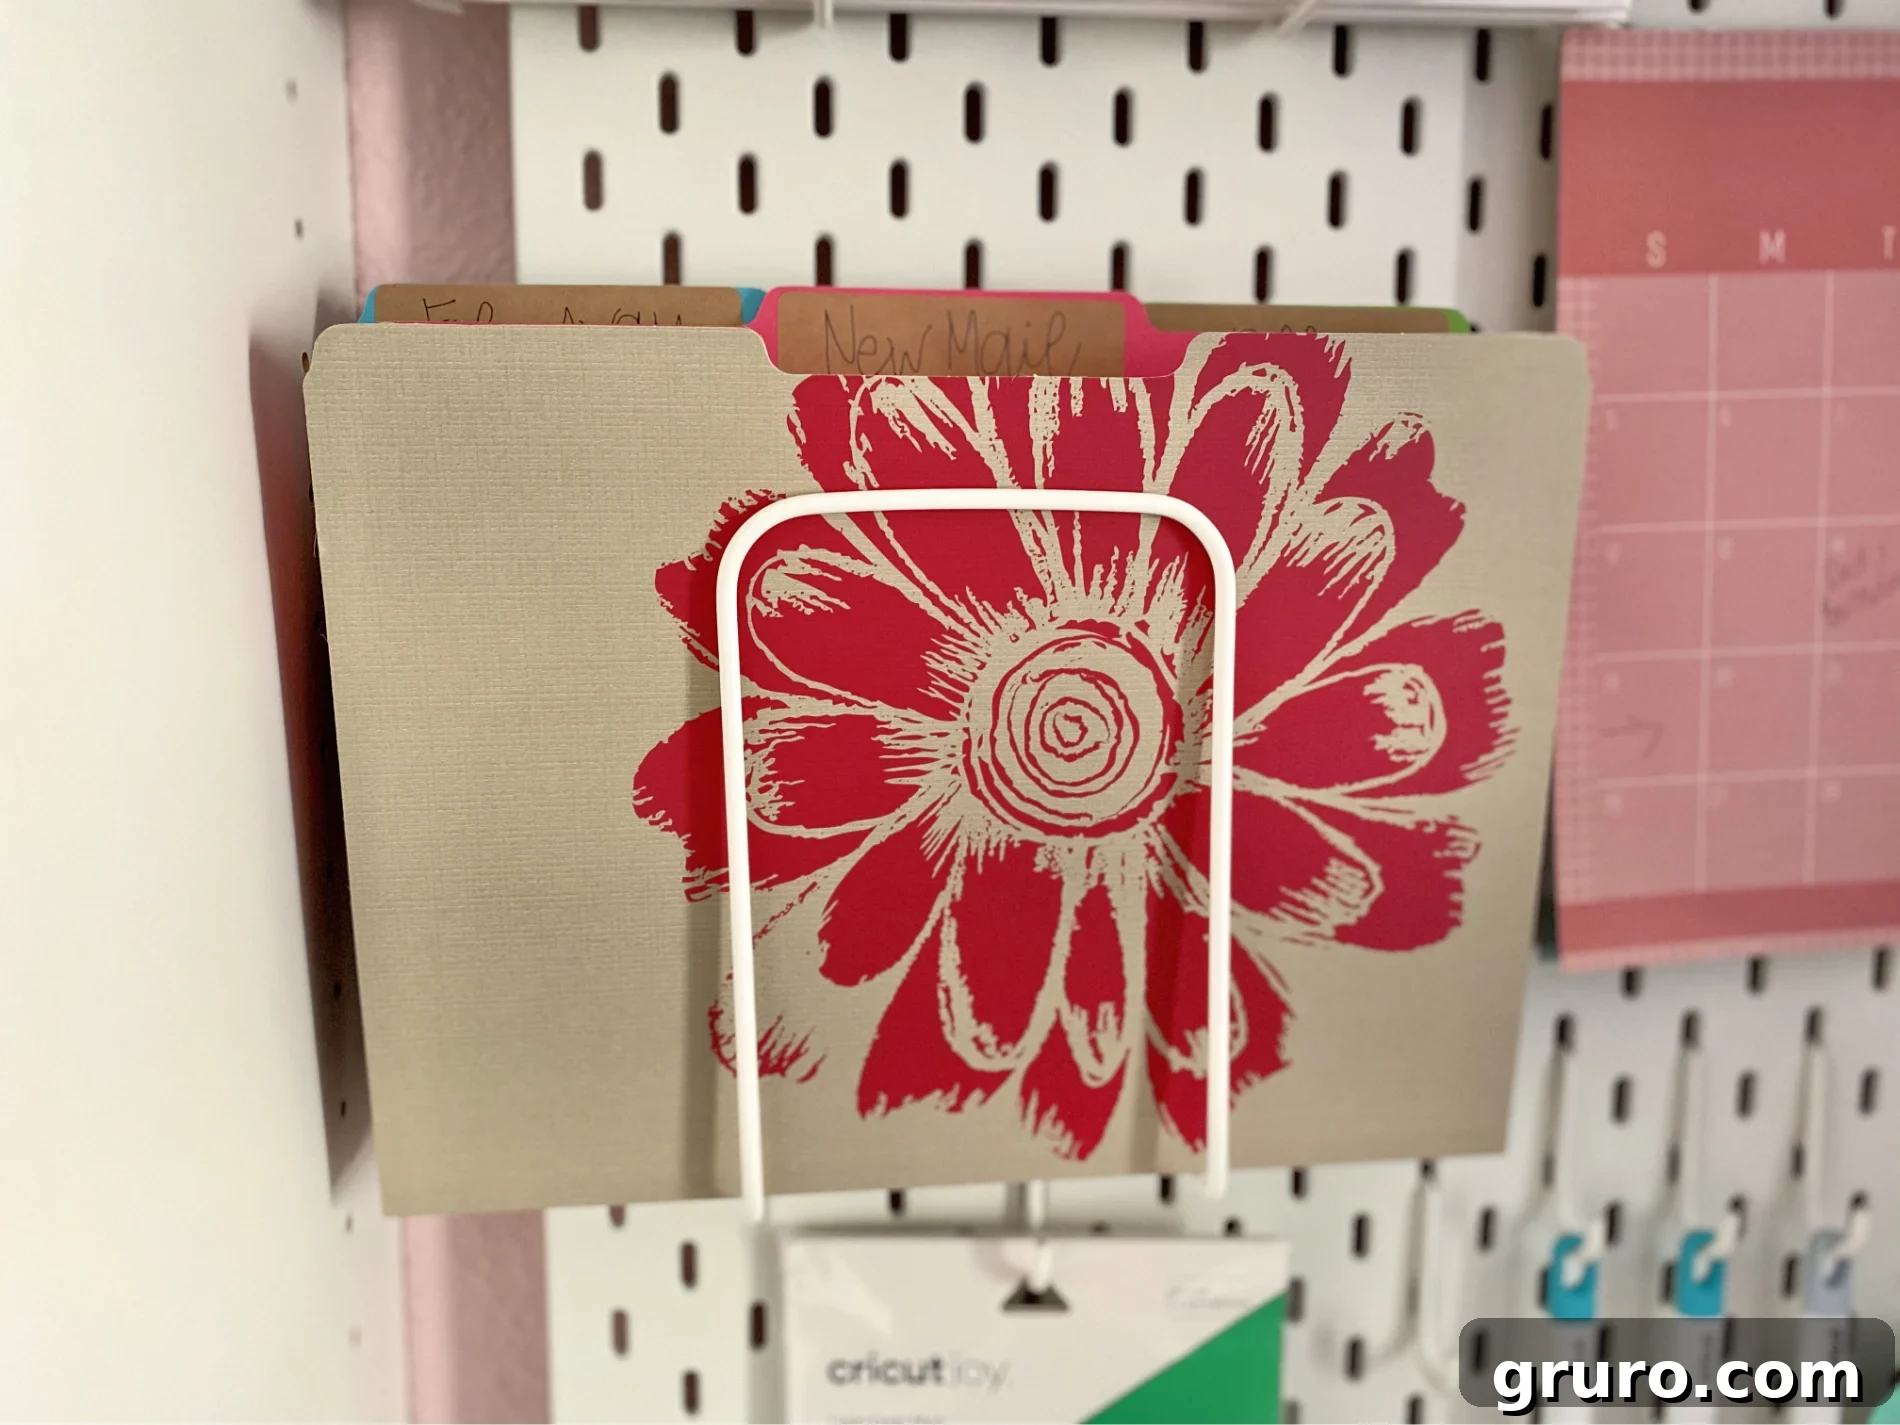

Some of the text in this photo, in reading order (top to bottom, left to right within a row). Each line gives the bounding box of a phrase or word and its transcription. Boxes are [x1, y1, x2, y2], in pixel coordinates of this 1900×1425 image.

[1646, 230, 1667, 269] S
[1758, 227, 1787, 264] M
[824, 304, 933, 376] New
[826, 1350, 943, 1387] cricut
